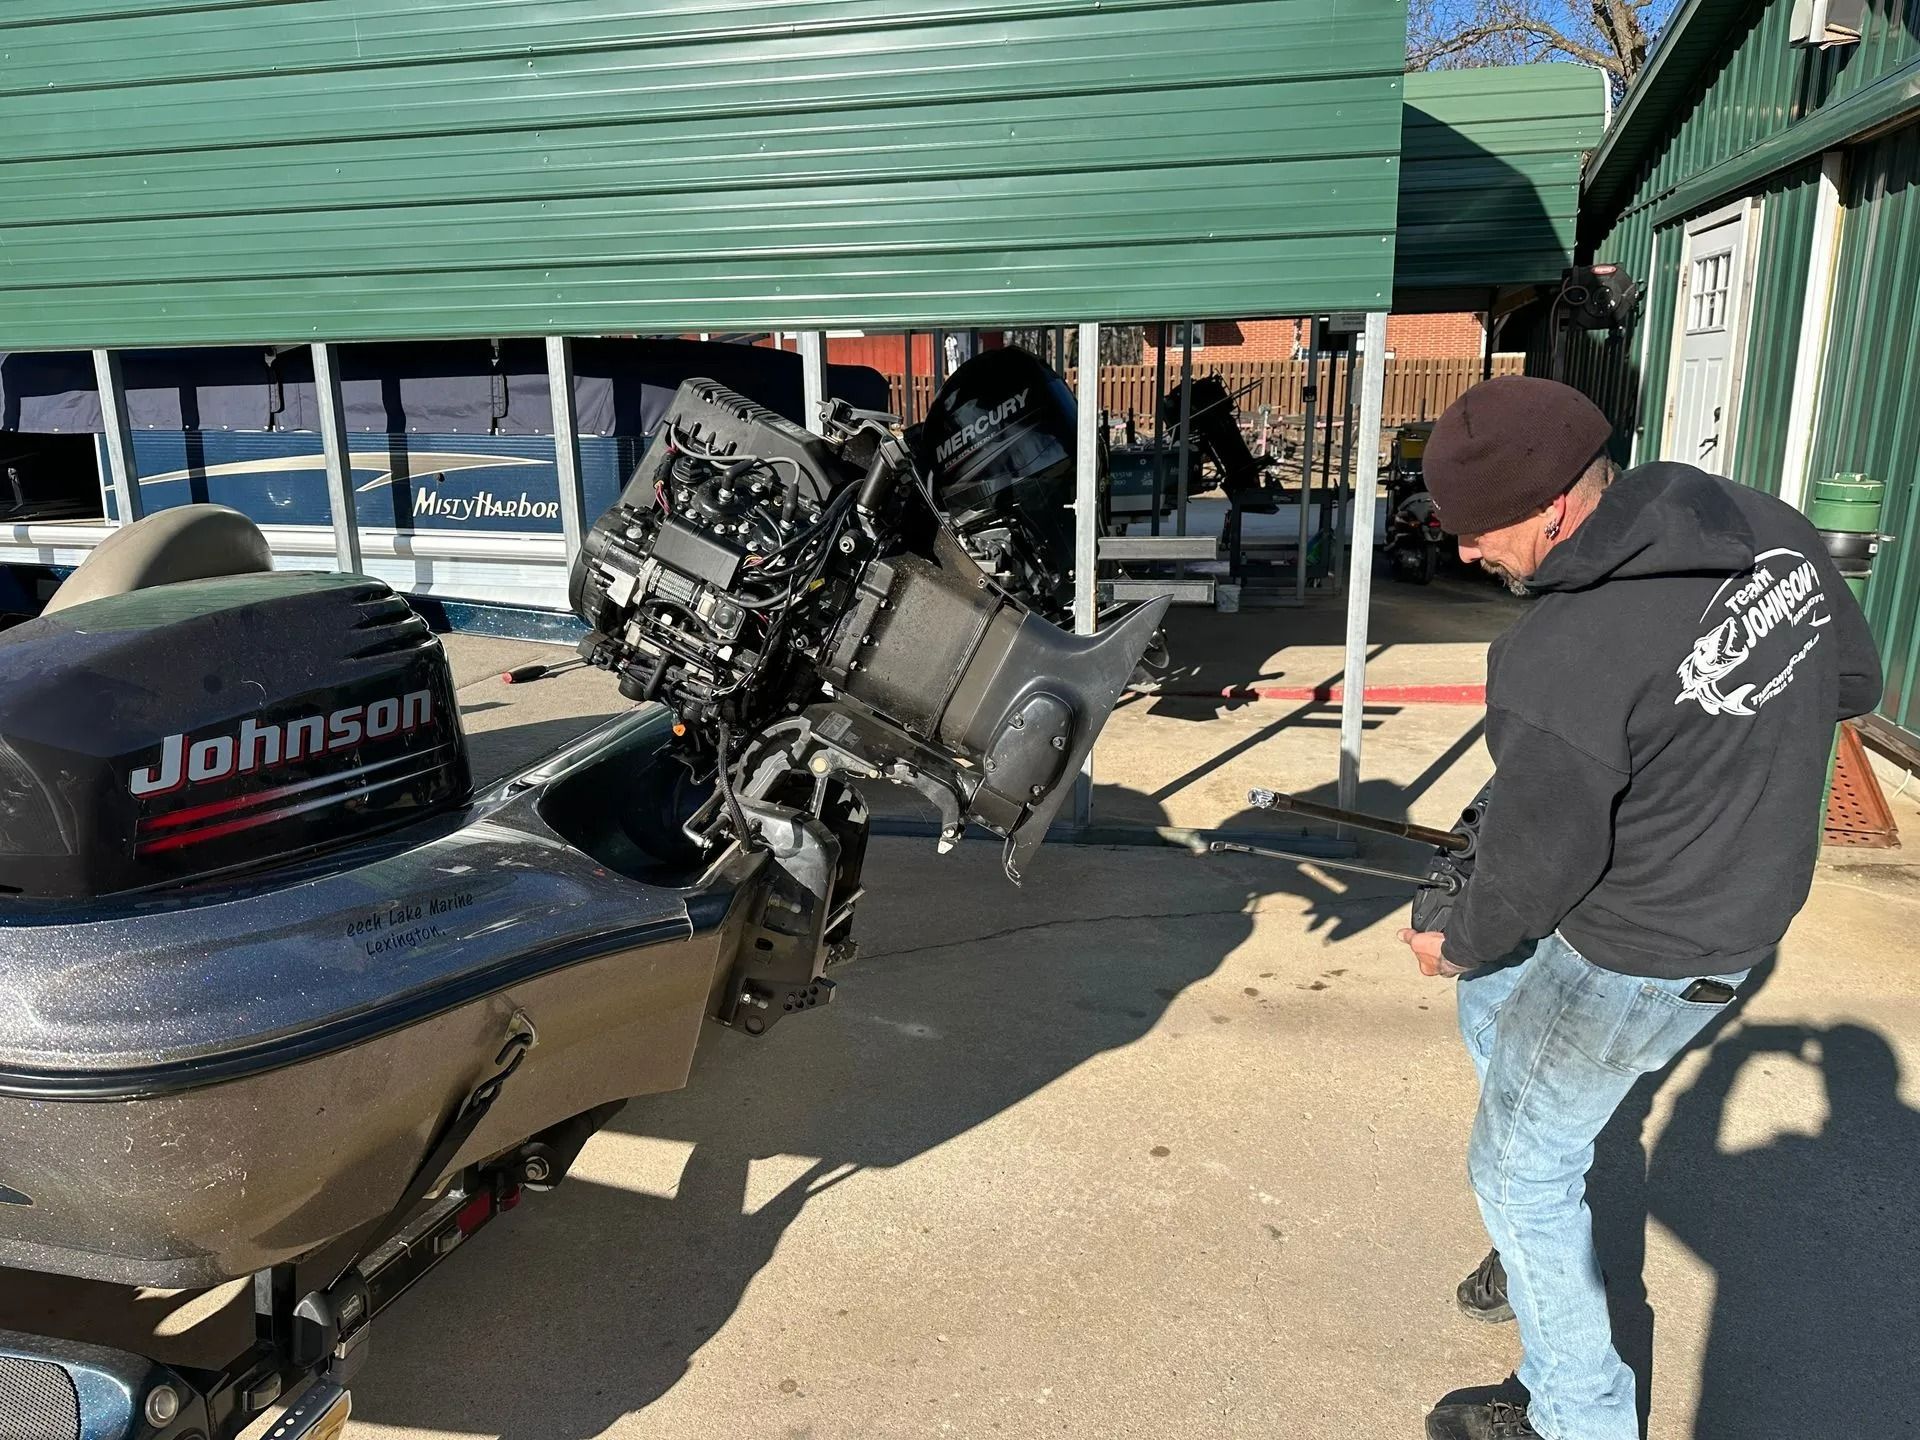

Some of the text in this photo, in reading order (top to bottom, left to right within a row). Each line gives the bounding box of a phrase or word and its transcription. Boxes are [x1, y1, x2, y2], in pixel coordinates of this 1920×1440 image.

[935, 388, 1030, 463] MERCURY
[1724, 566, 1775, 615] Team
[1741, 562, 1813, 649] JOHNSON
[129, 689, 434, 798] Johnson
[389, 905, 422, 927] Lake
[429, 893, 473, 917] Marine
